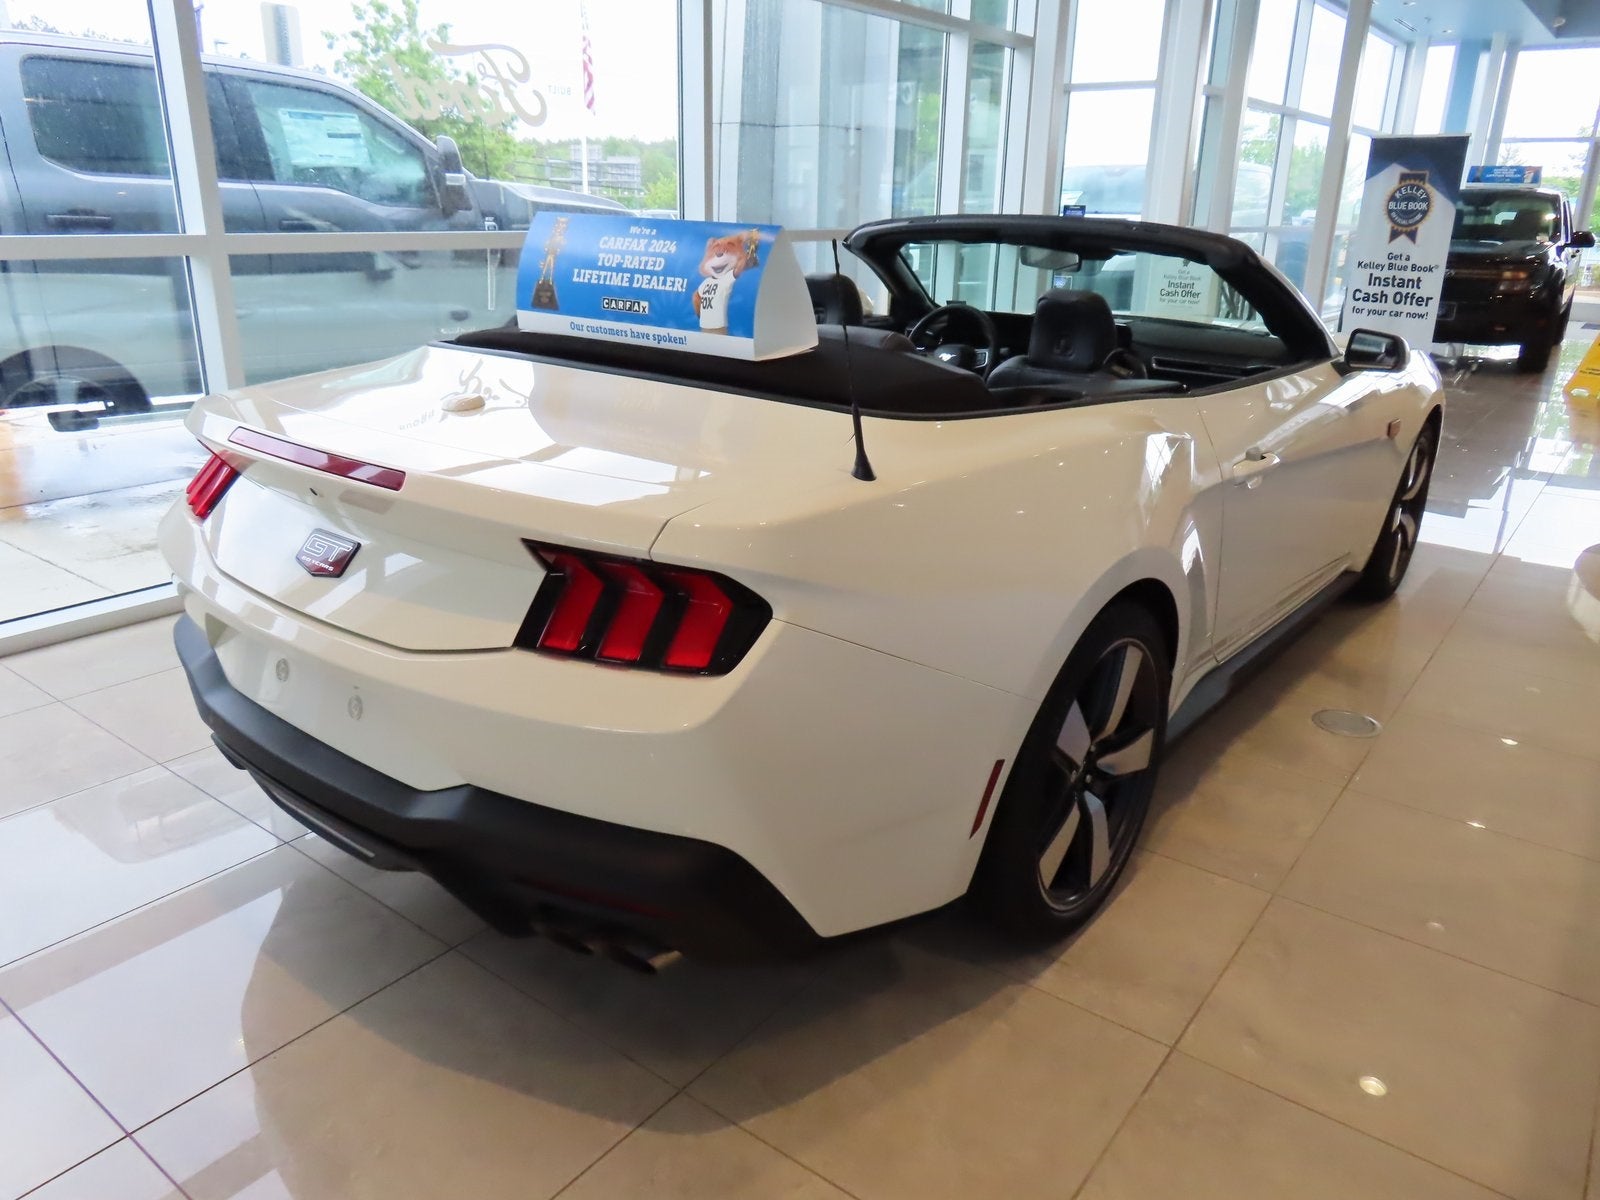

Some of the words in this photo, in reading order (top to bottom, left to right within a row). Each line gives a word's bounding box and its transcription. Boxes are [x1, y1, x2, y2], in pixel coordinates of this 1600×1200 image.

[1395, 186, 1427, 199] KELLEY
[1388, 201, 1408, 210] BLUE
[1408, 202, 1429, 210] BOOK
[629, 226, 651, 235] We're
[651, 228, 657, 236] a
[599, 236, 646, 252] CARFAX
[648, 239, 677, 254] 2024
[597, 253, 665, 271] TOP-RATED
[1387, 252, 1404, 261] Get
[1404, 254, 1411, 262] a
[1357, 260, 1386, 271] Kelley
[1387, 262, 1409, 272] Blue
[572, 268, 631, 287] LIFETIME
[632, 273, 688, 292] DEALER!
[1168, 280, 1195, 289] Instant
[1367, 272, 1422, 290] Instant
[1160, 289, 1179, 297] Cash
[1181, 290, 1201, 299] Offer
[1352, 288, 1389, 304] Cash
[1392, 290, 1434, 308] Offer
[602, 297, 649, 314] CARFAX
[1352, 306, 1365, 314] for
[1366, 307, 1387, 317] your
[1388, 309, 1404, 318] car
[1405, 311, 1429, 320] now!
[569, 321, 585, 332] Our
[586, 324, 629, 338] customers
[629, 328, 651, 341] have
[652, 332, 688, 346] spoken!
[303, 533, 353, 562] GT
[311, 558, 335, 572] YEARS
